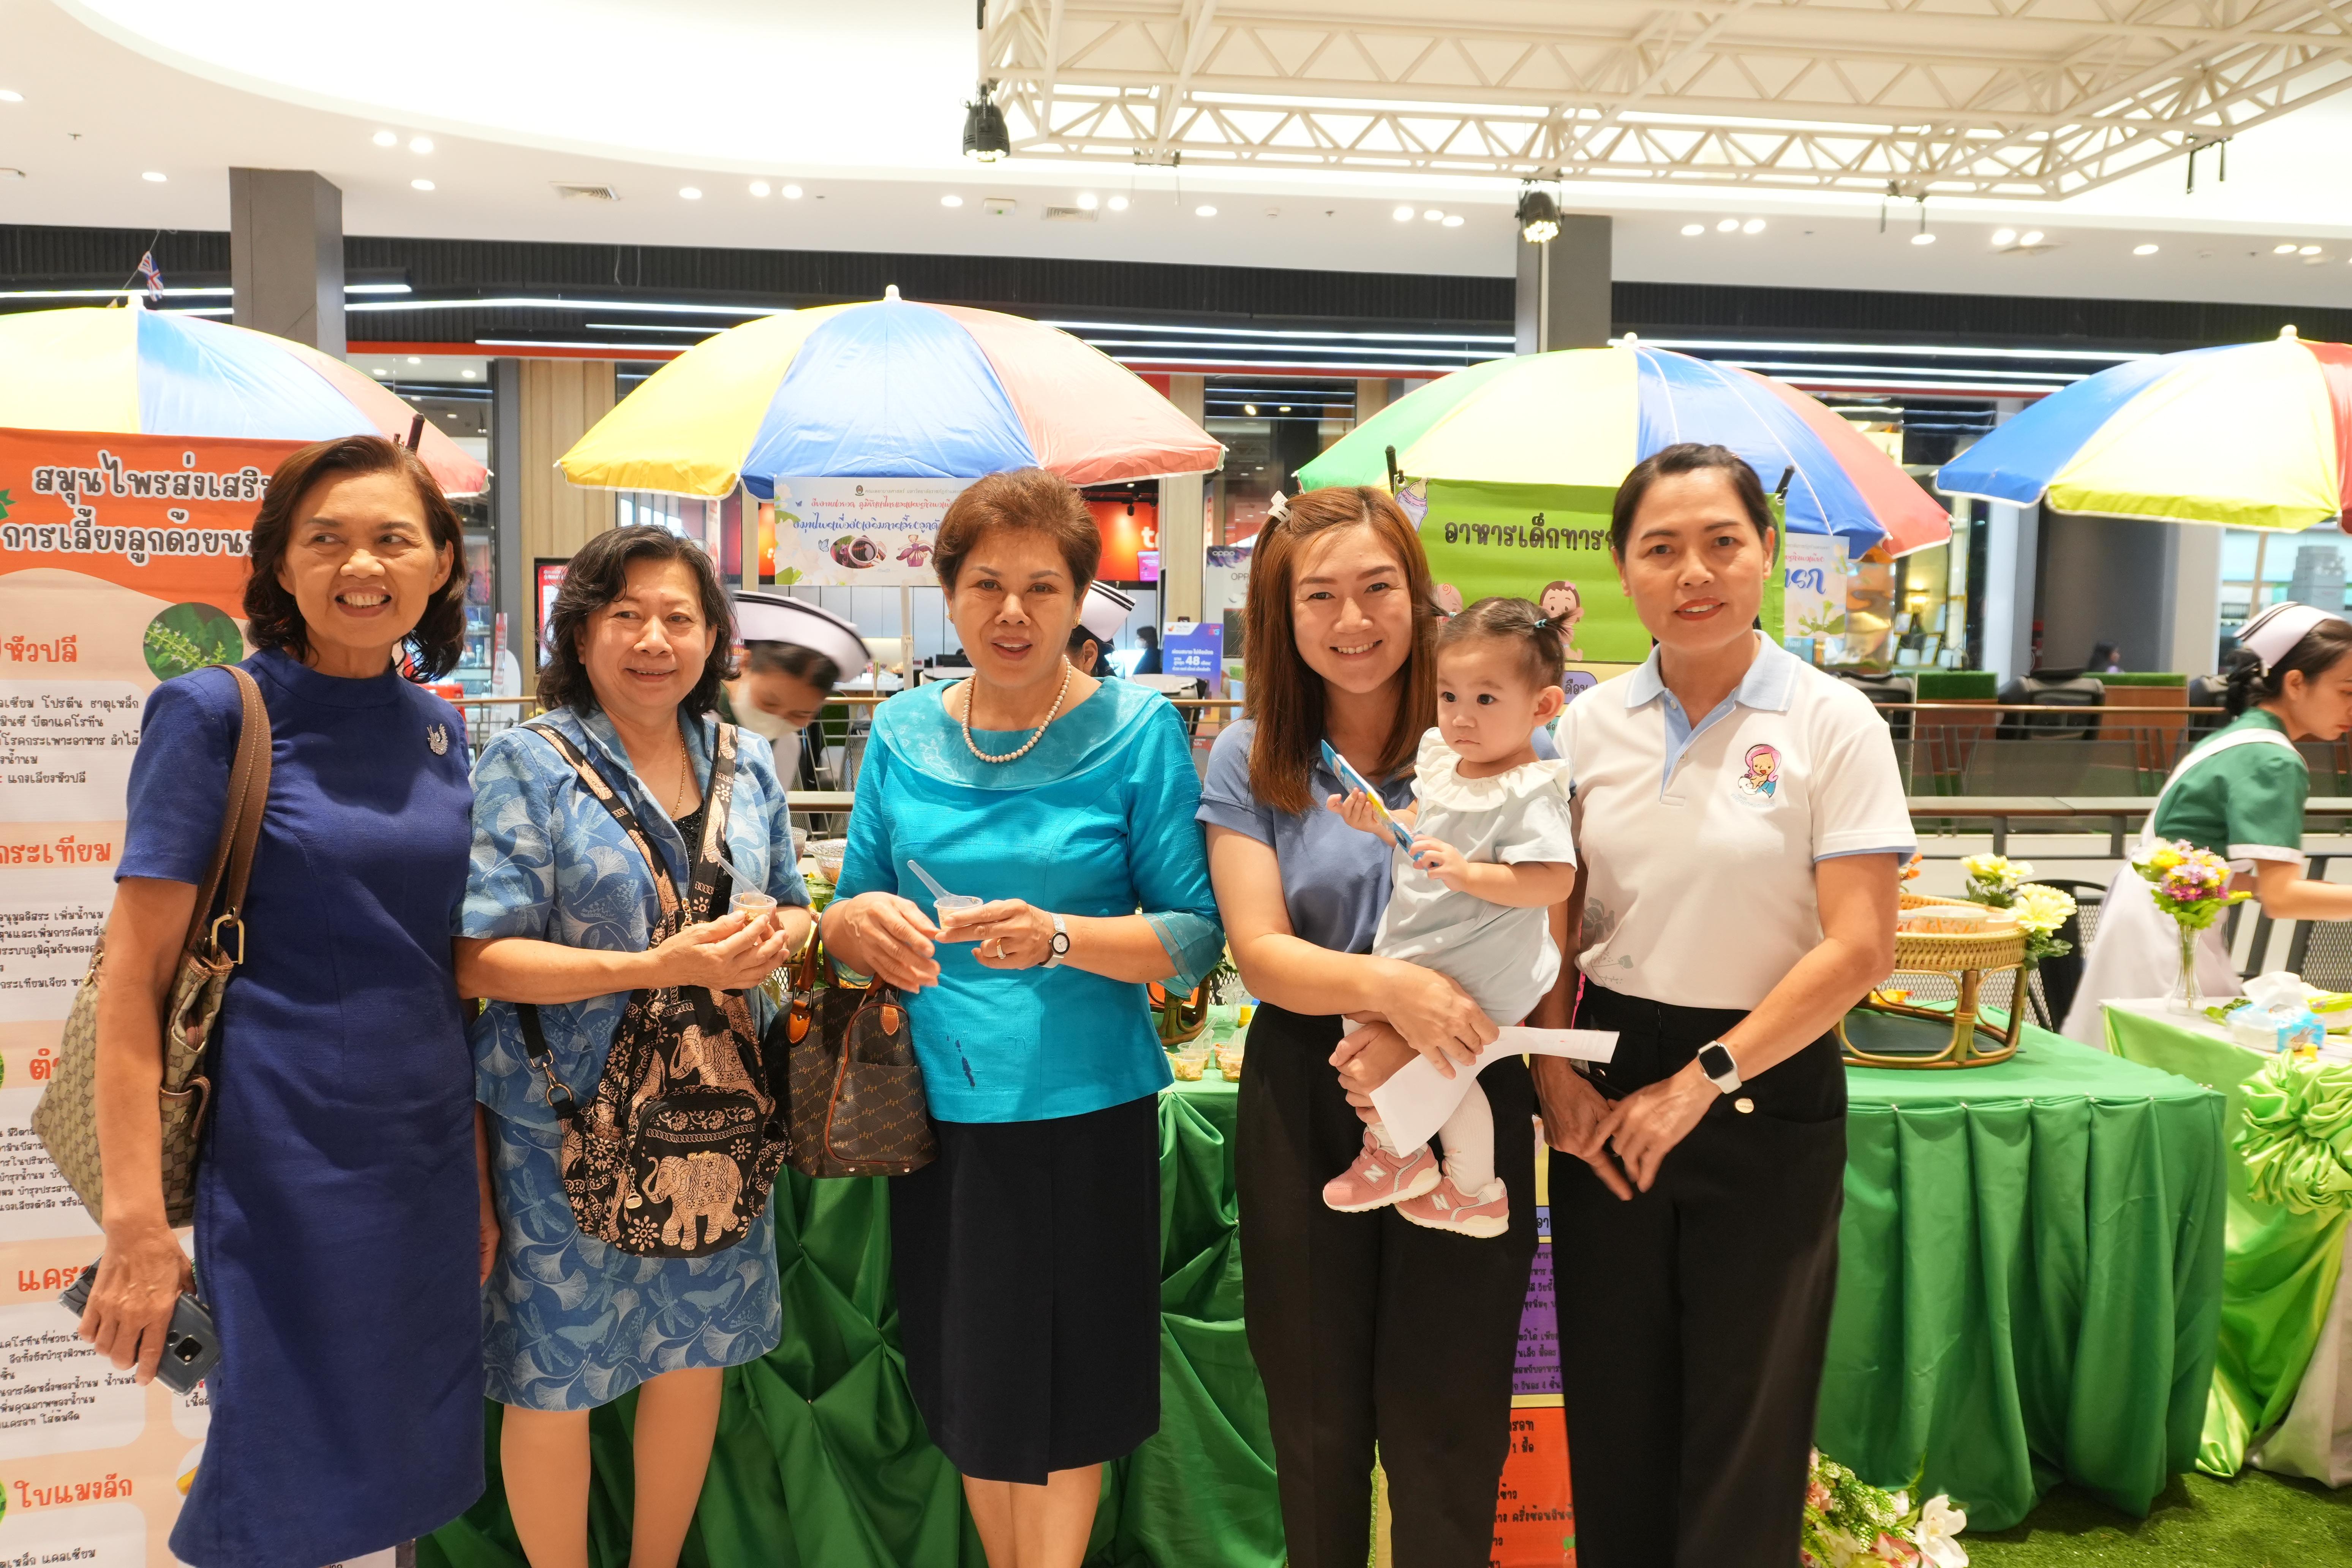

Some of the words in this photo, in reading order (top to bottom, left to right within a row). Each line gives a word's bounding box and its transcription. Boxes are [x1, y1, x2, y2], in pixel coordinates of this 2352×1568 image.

[793, 512, 940, 534] สมุนไพรเพื่อส่งเสริมการเลี้ยงลูกด้
[3, 508, 252, 563] การเลี้ยงลูกด้วยน
[4, 635, 77, 662] หัวปลี
[1185, 656, 1200, 665] 48
[41, 695, 82, 708] โปรตีน
[91, 695, 139, 713] ธาตุเหล็ก
[0, 730, 105, 745] โรคกระเพาะอาหาร
[8, 771, 86, 783] แกงเลียงหัวปลี
[0, 835, 111, 864] กระเทียม
[55, 906, 103, 921] เพิ่มน้ำนม
[0, 940, 95, 958] ระบบภูมิคุ้มกันของ
[0, 1418, 36, 1429] แครอท
[1510, 1421, 1534, 1431] รอท
[14, 1473, 132, 1508] ใบแมงลัก
[1498, 1483, 1517, 1500] ข้าว
